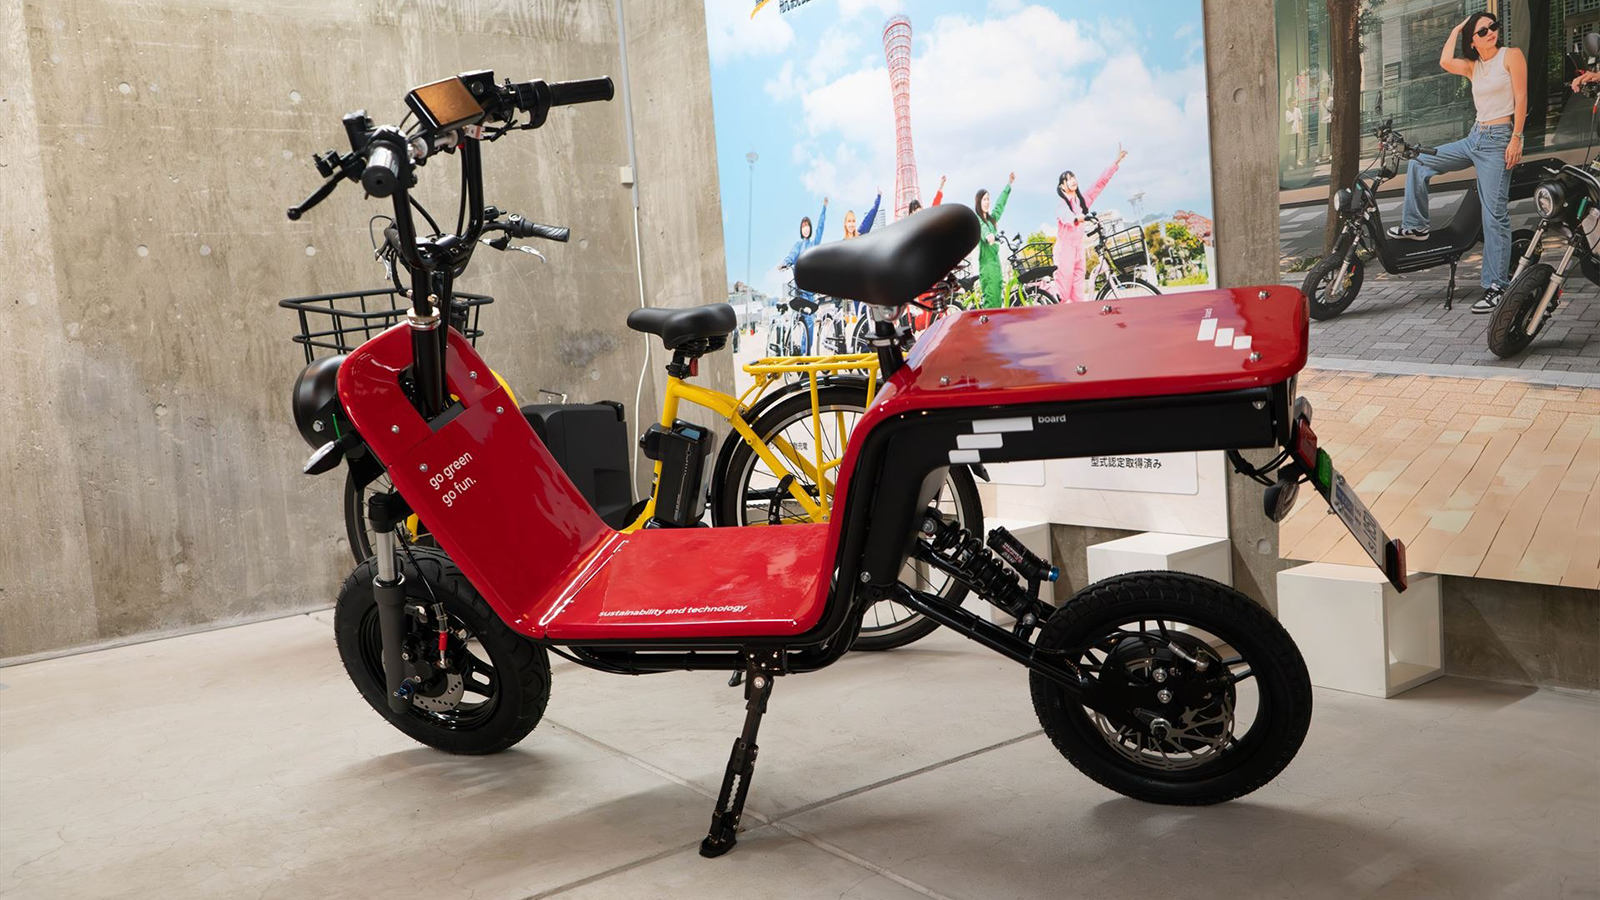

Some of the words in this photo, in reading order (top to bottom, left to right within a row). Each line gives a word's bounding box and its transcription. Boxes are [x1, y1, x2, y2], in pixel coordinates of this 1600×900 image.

[1037, 414, 1066, 424] board
[1090, 456, 1162, 469] 型式認定取得済み
[429, 473, 444, 490] go
[443, 452, 473, 480] green
[441, 490, 457, 508] go
[453, 477, 477, 494] fun.
[598, 608, 665, 617] sustainability
[665, 606, 686, 615] and
[687, 604, 748, 613] technology
